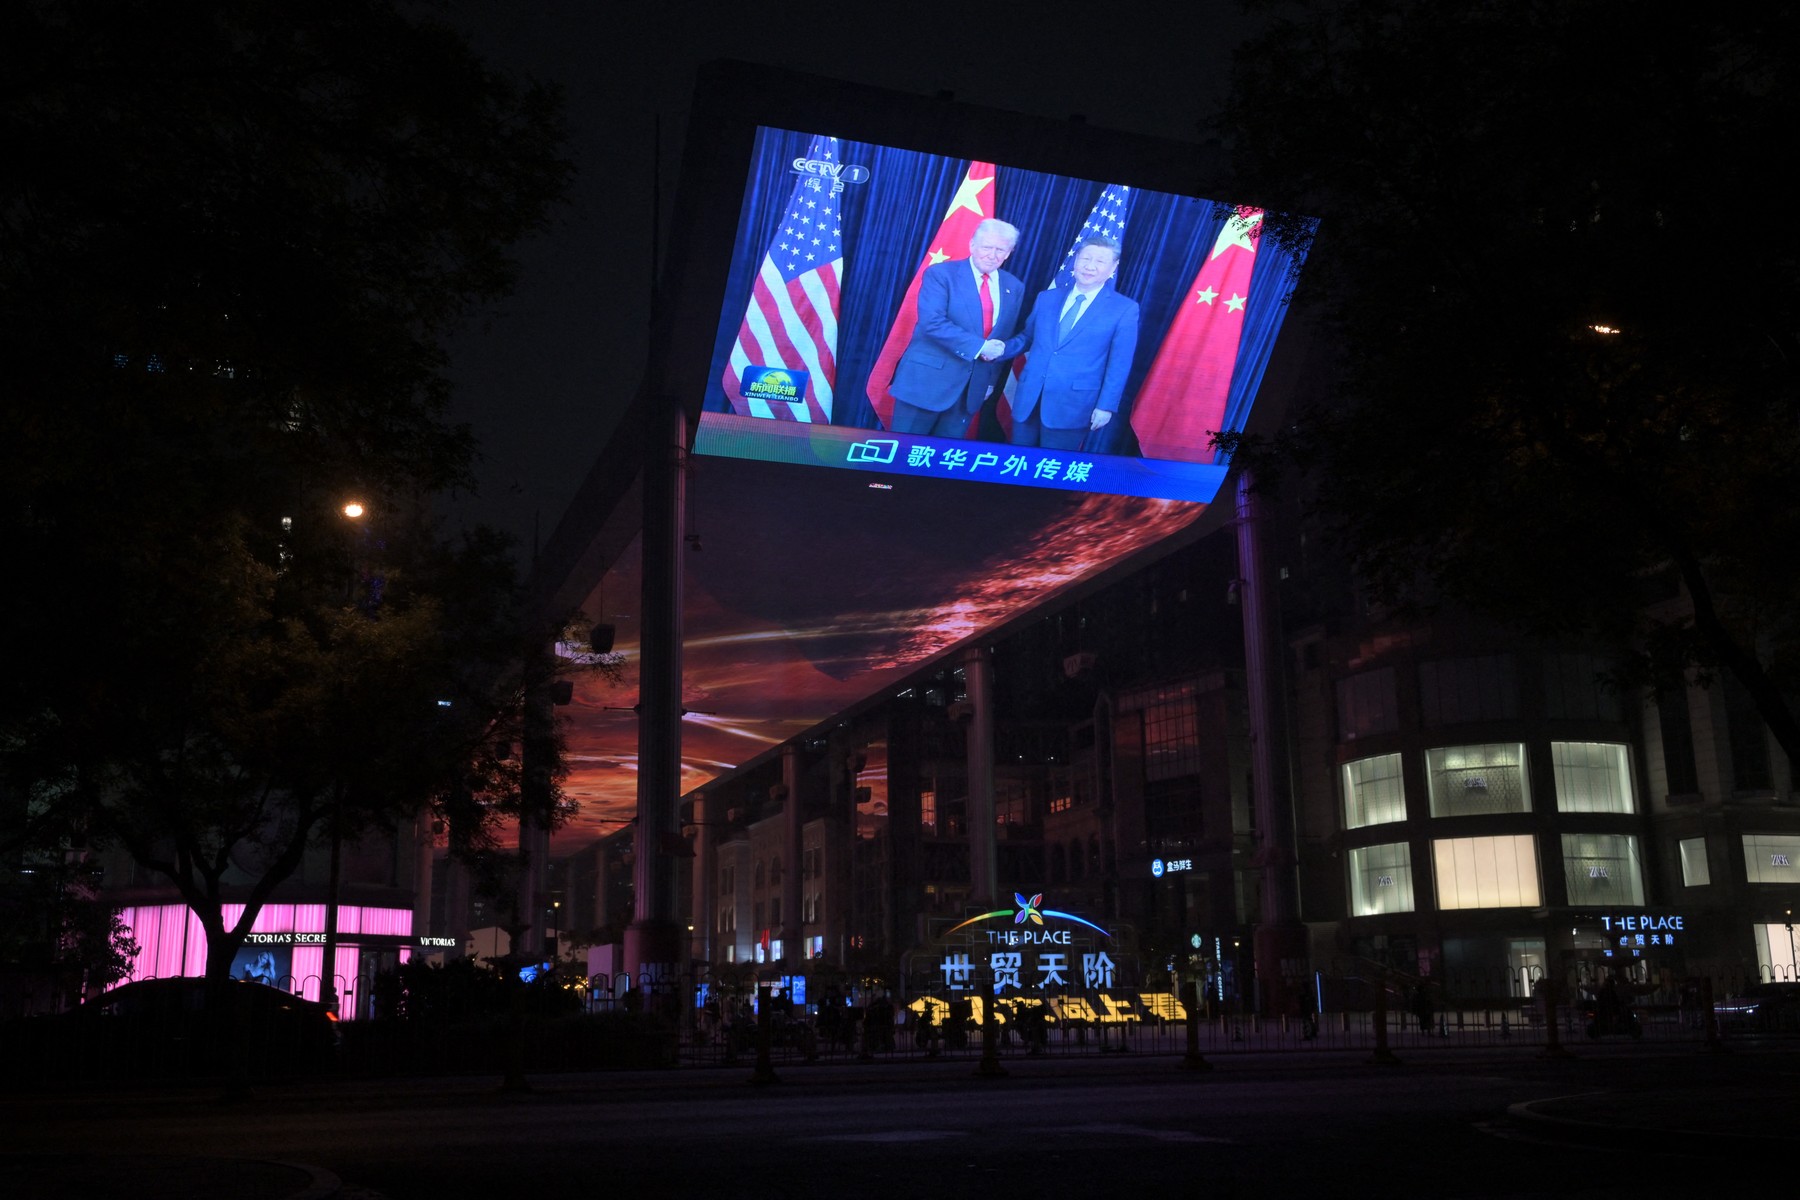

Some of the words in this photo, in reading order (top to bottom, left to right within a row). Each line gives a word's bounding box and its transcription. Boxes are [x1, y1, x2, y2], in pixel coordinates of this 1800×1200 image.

[793, 158, 844, 176] CCTV
[853, 168, 860, 181] 1
[749, 382, 797, 396] 新闻联播
[907, 445, 1094, 483] 歌华户外传媒
[1166, 859, 1193, 873] 盒马鲜生
[1640, 916, 1684, 930] PLACE
[294, 933, 327, 943] SECRE
[986, 930, 1018, 945] THE
[1023, 929, 1072, 945] PLACE
[940, 951, 1116, 990] 世贸天阶
